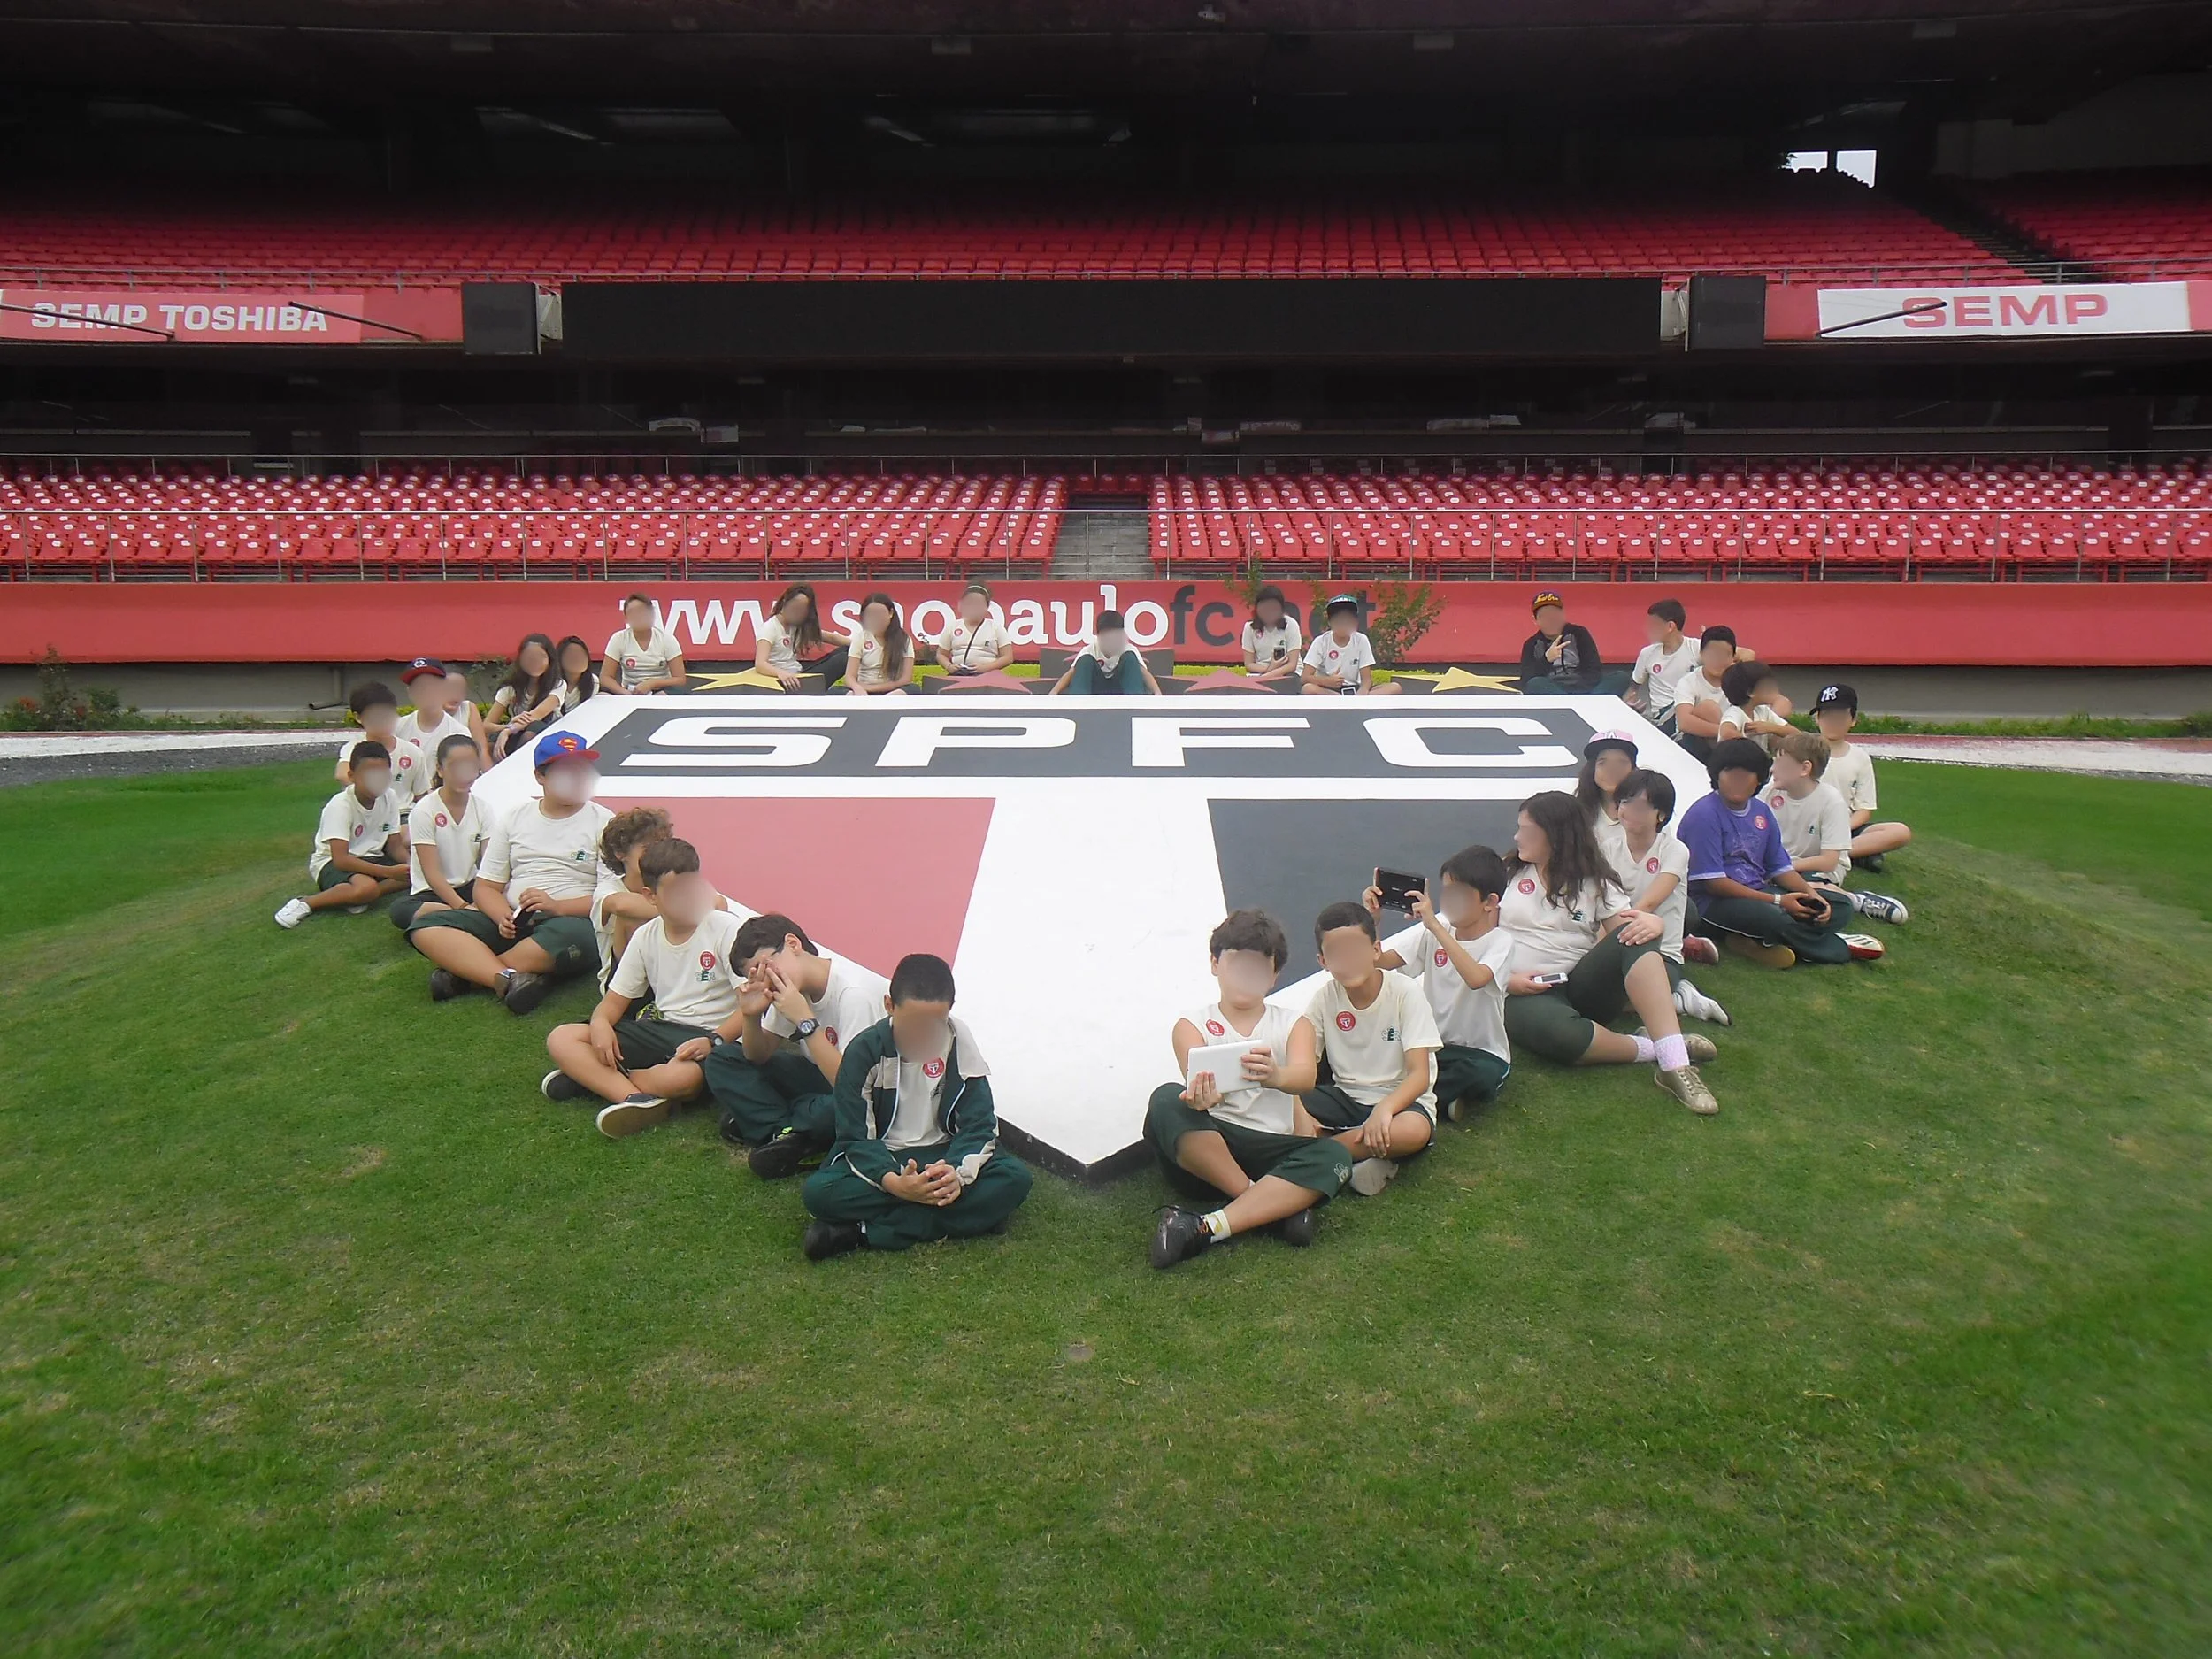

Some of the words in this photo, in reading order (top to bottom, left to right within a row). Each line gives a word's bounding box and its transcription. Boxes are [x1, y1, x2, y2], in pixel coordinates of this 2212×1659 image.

[31, 303, 149, 329] SEMP
[159, 305, 328, 332] TOSHIBA
[1901, 294, 2109, 329] SEMP
[619, 716, 1578, 768] SPFC
